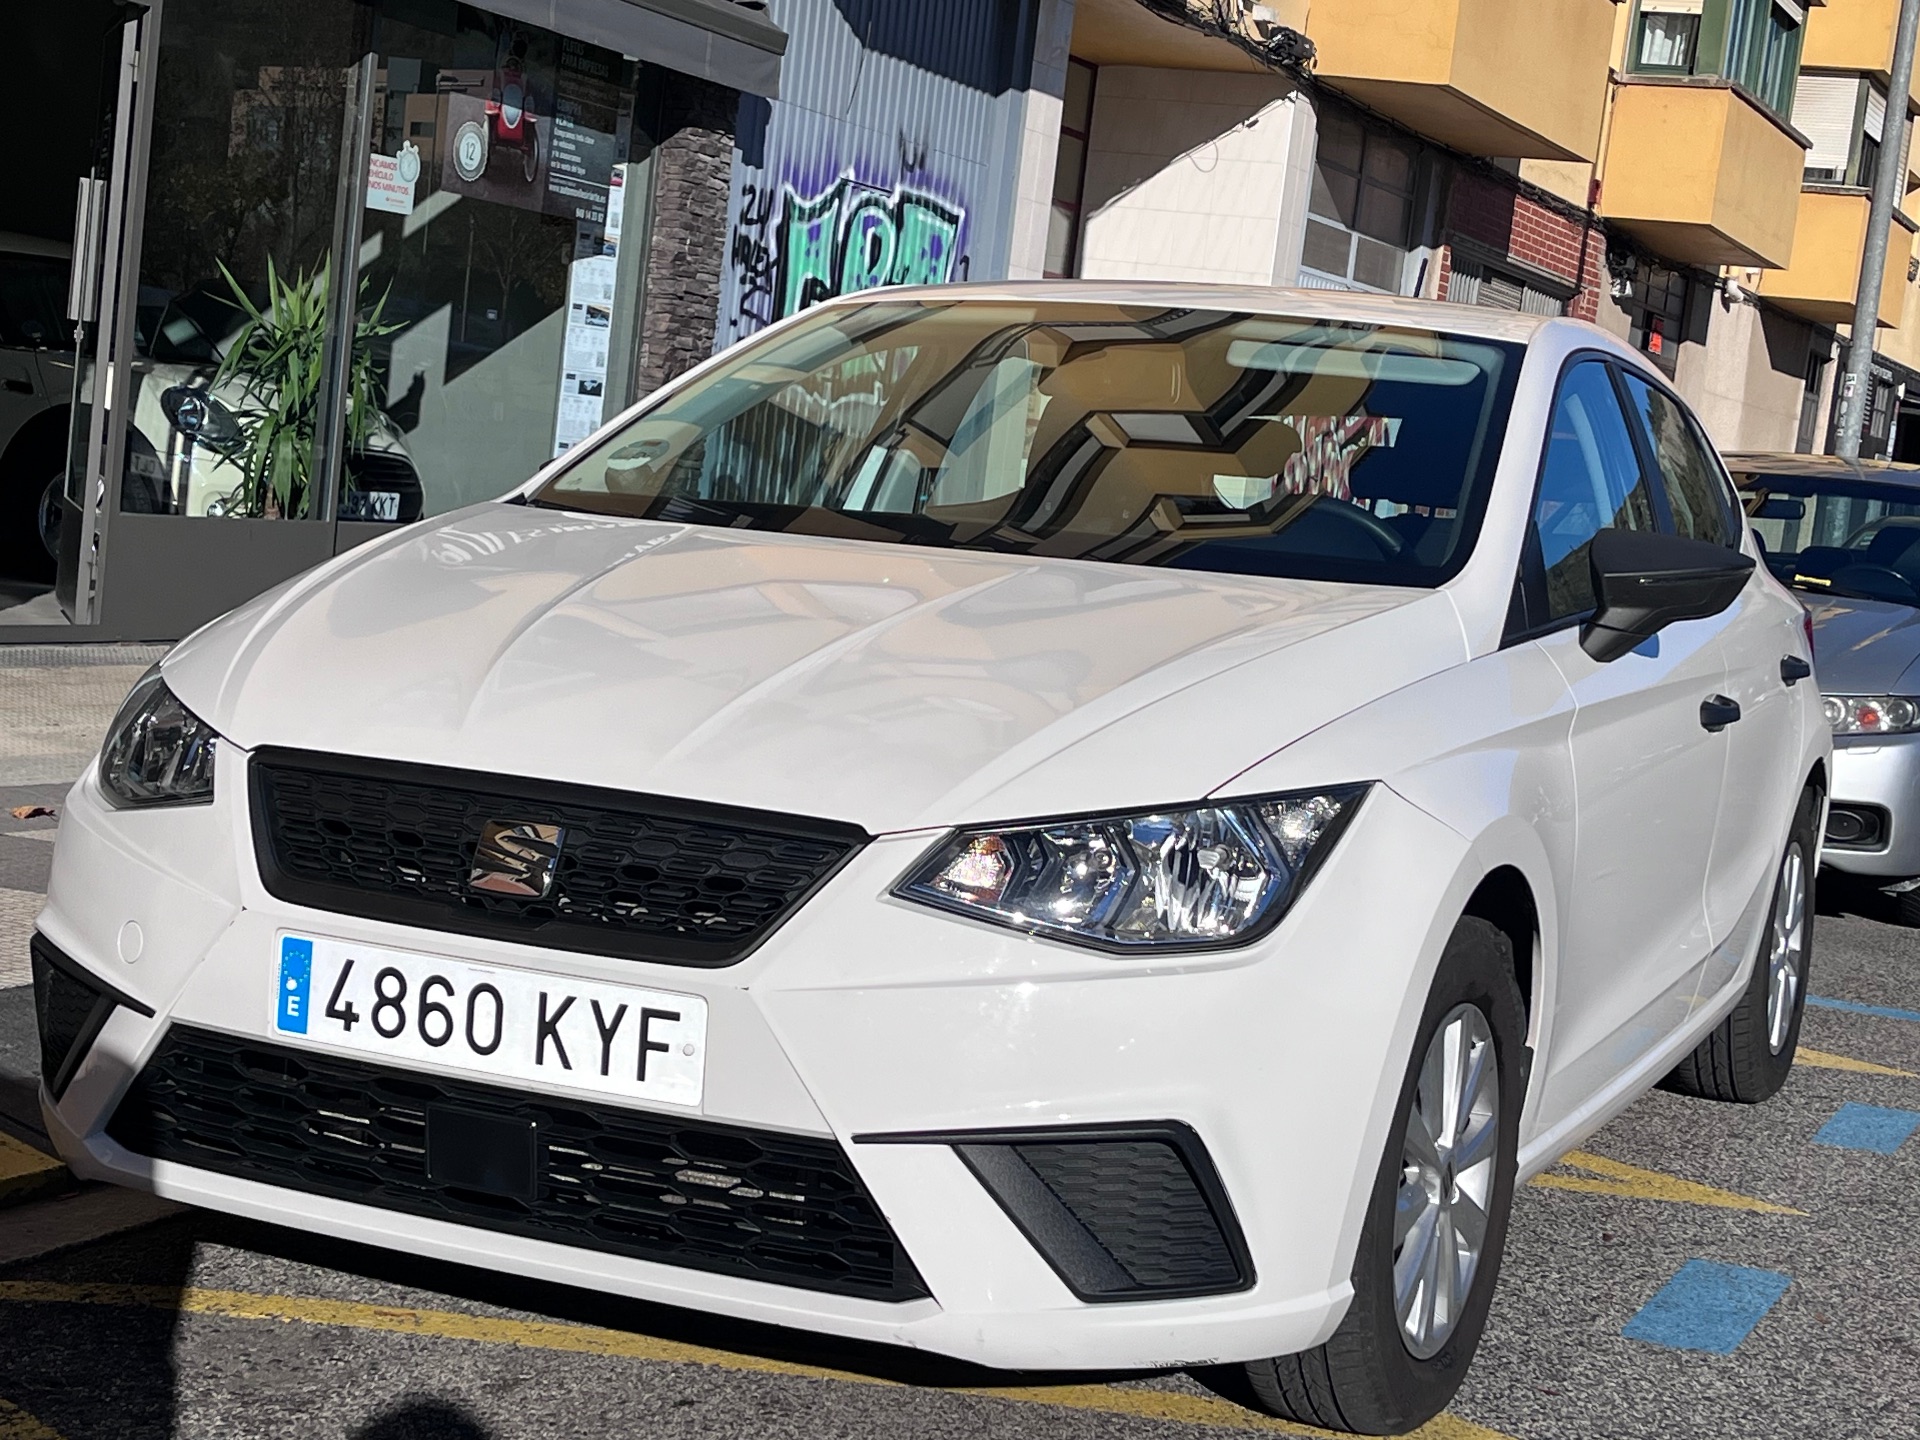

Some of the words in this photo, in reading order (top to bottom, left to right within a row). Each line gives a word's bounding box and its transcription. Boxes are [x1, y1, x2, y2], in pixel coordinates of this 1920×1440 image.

[466, 141, 476, 161] 12
[371, 495, 397, 517] KKT
[286, 995, 301, 1017] E
[324, 958, 504, 1056] 4860
[535, 990, 681, 1082] KYF
